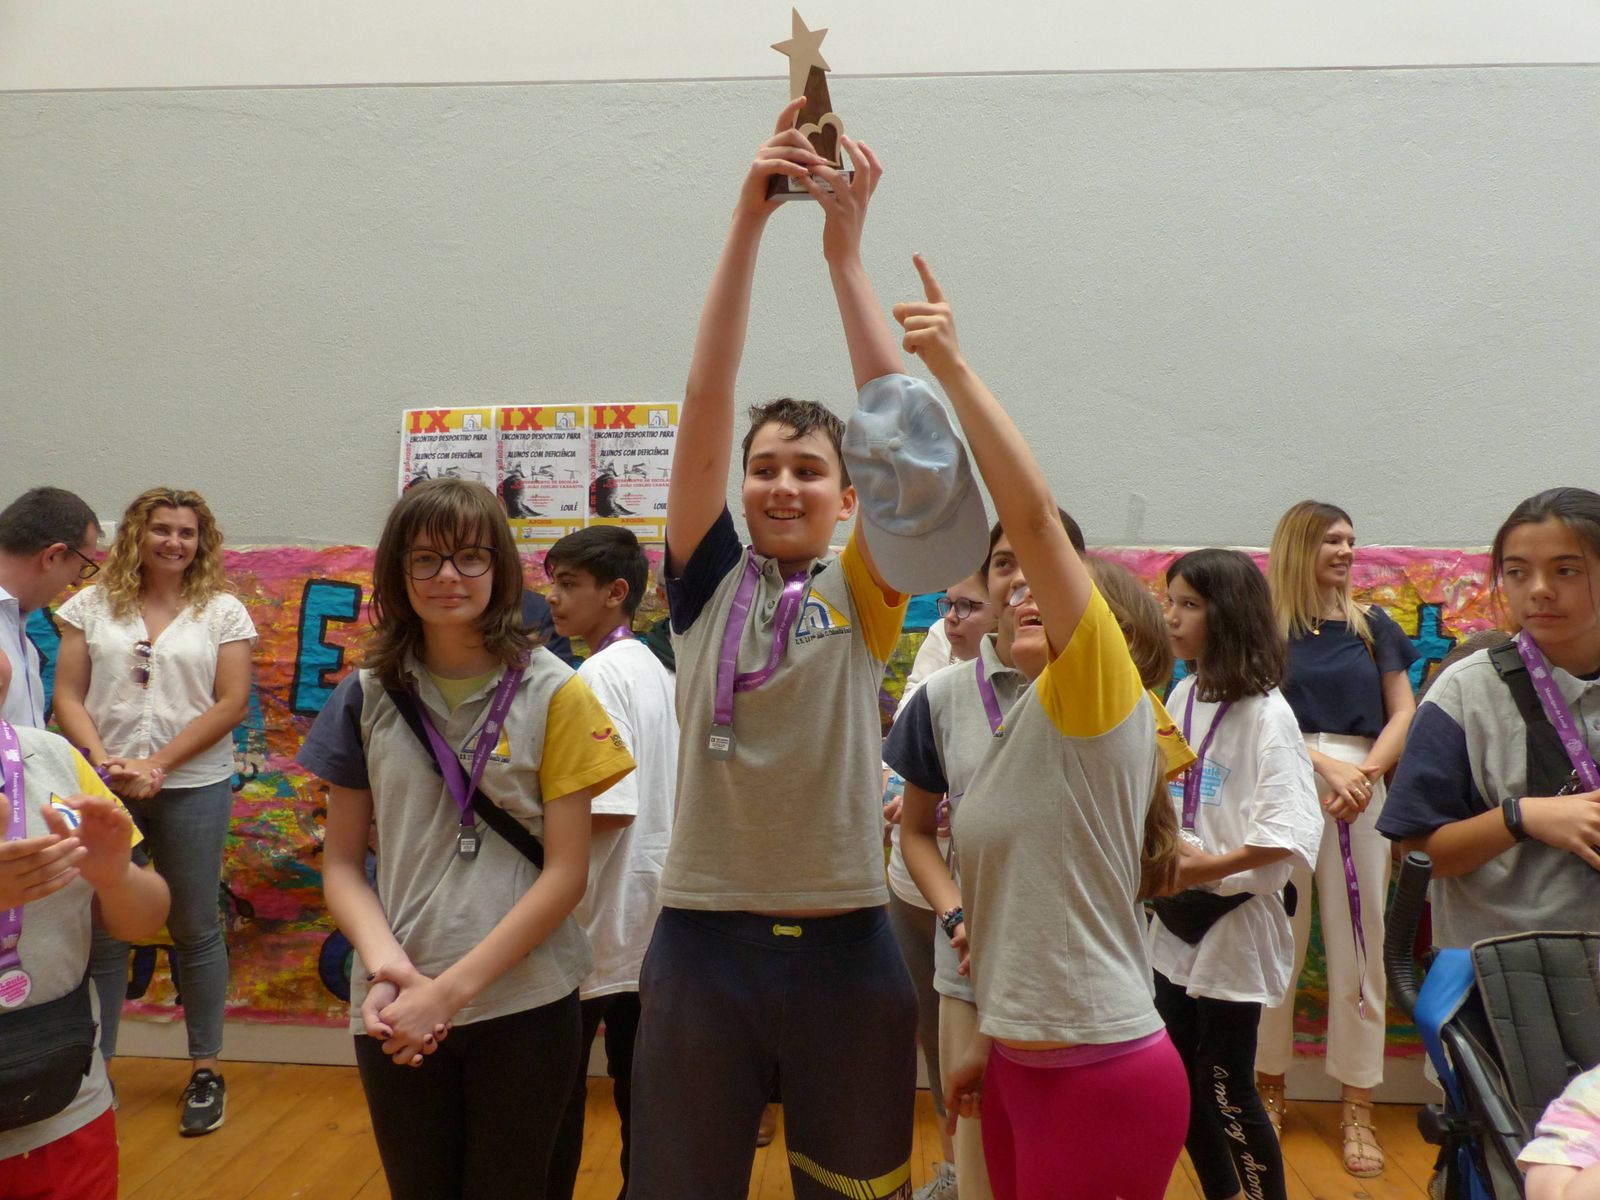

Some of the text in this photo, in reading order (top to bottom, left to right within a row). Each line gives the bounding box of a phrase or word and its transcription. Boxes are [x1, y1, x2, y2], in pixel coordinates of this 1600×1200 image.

[410, 410, 451, 433] IX
[501, 407, 543, 431] IX
[593, 405, 636, 429] IX
[501, 432, 531, 440] ENCONTRO
[531, 432, 566, 440] DESPORTIVO
[594, 430, 674, 439] ENCONTRO DESPORTIVO PARA
[451, 449, 483, 459] DEFICIÊNCIA
[544, 447, 576, 457] DEFICIÊNCIA
[637, 446, 669, 456] DEFICIÊNCIA
[560, 501, 578, 512] LOULÉ
[653, 502, 668, 510] LOUL
[12, 771, 20, 798] Município
[1213, 1081, 1242, 1120] you
[1224, 1121, 1248, 1145] be
